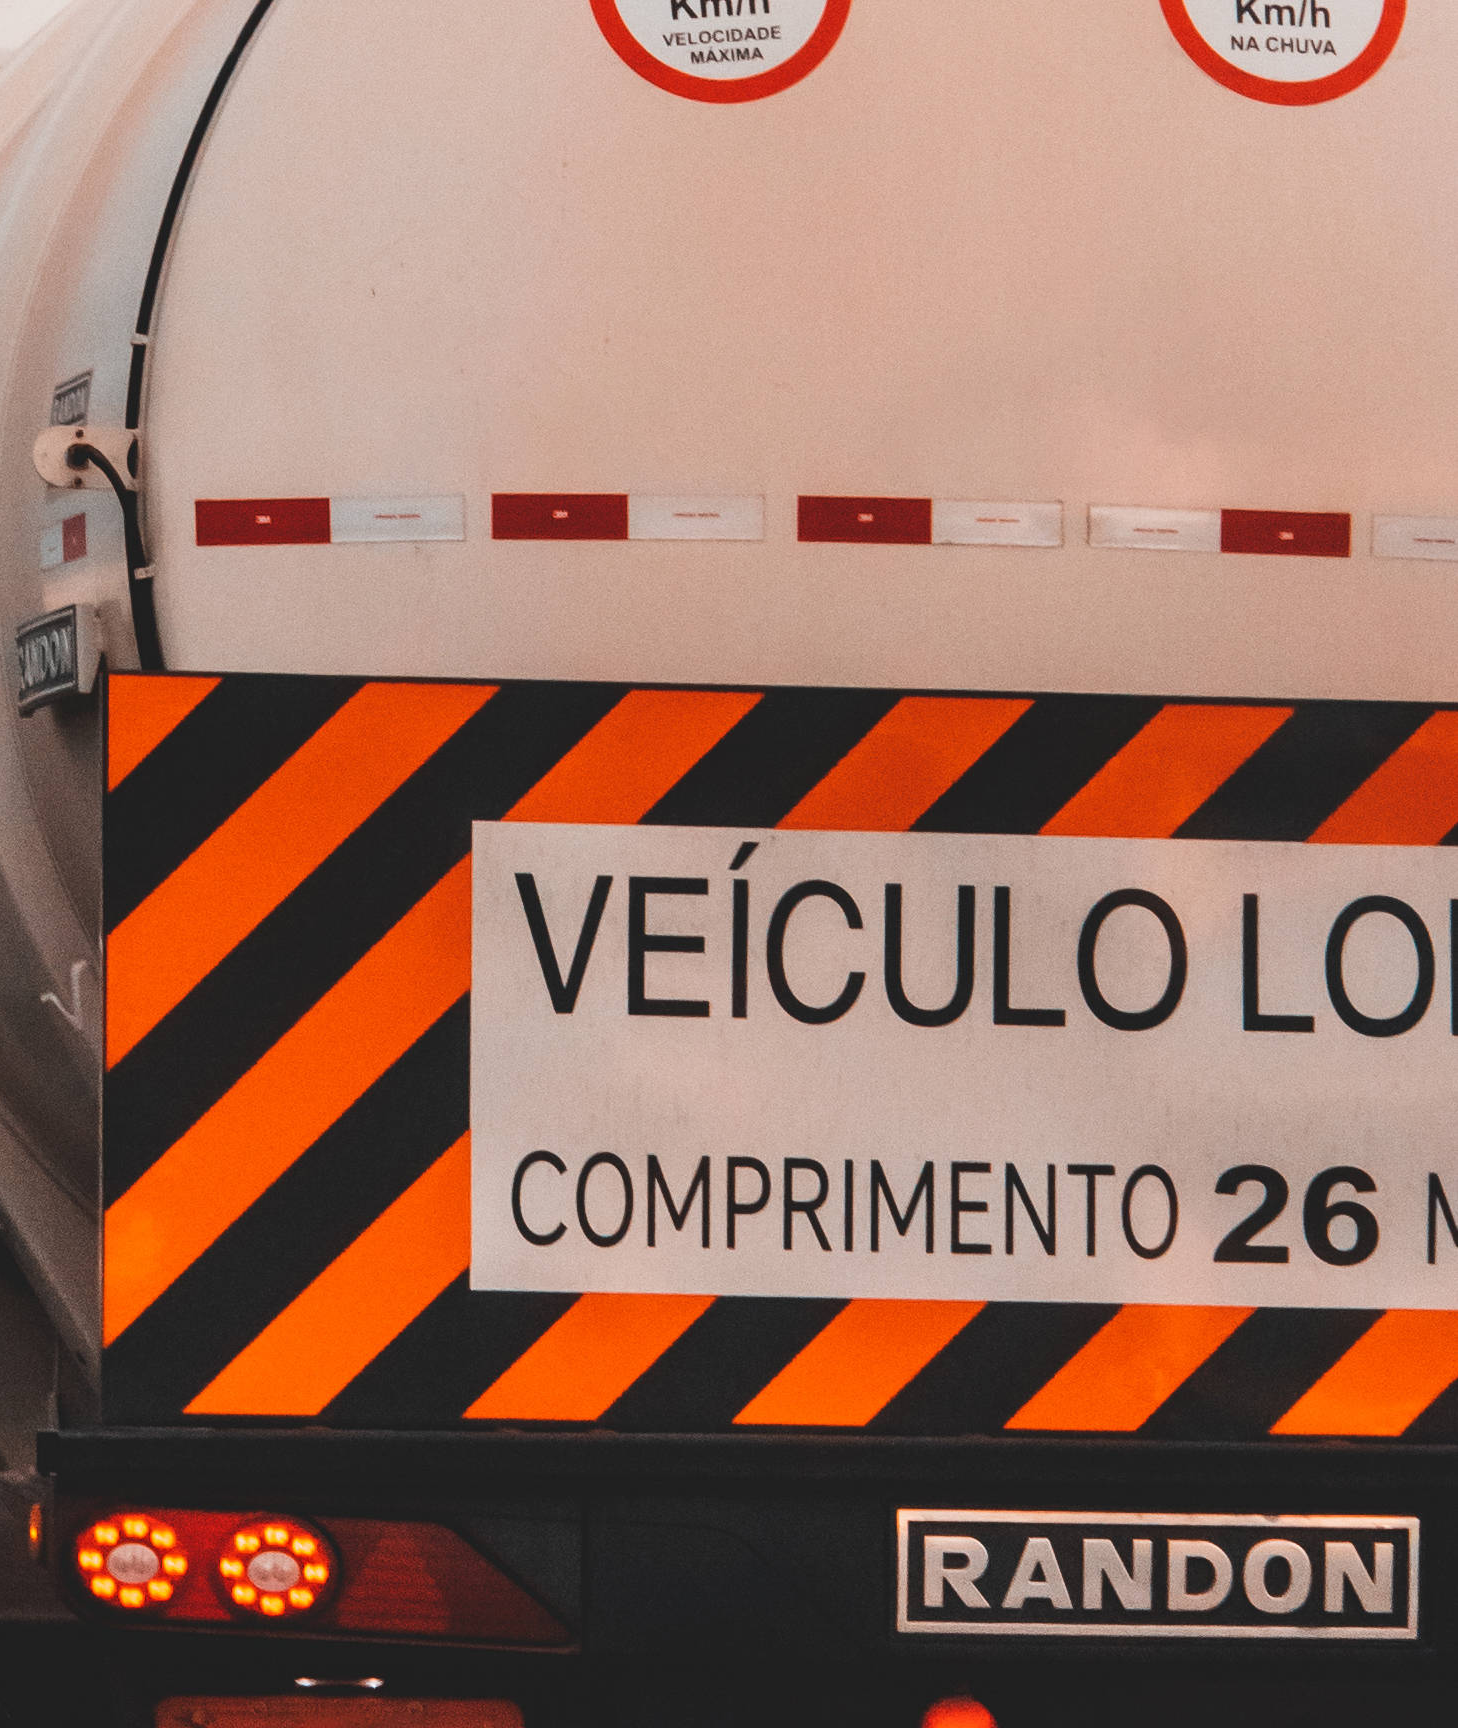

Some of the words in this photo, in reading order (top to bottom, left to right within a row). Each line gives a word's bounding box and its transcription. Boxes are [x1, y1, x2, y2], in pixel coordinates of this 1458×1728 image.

[662, 25, 783, 47] VELOCIDADE
[690, 44, 765, 64] MÁXIMA
[1230, 35, 1261, 52] NA
[1265, 35, 1338, 56] CHUVA
[514, 841, 1189, 1033] VEÍCULO
[1241, 890, 1458, 1040] LO
[511, 1150, 1180, 1260] COMPRIMENTO
[1213, 1164, 1381, 1267] 26
[923, 1534, 1395, 1614] RANDON
